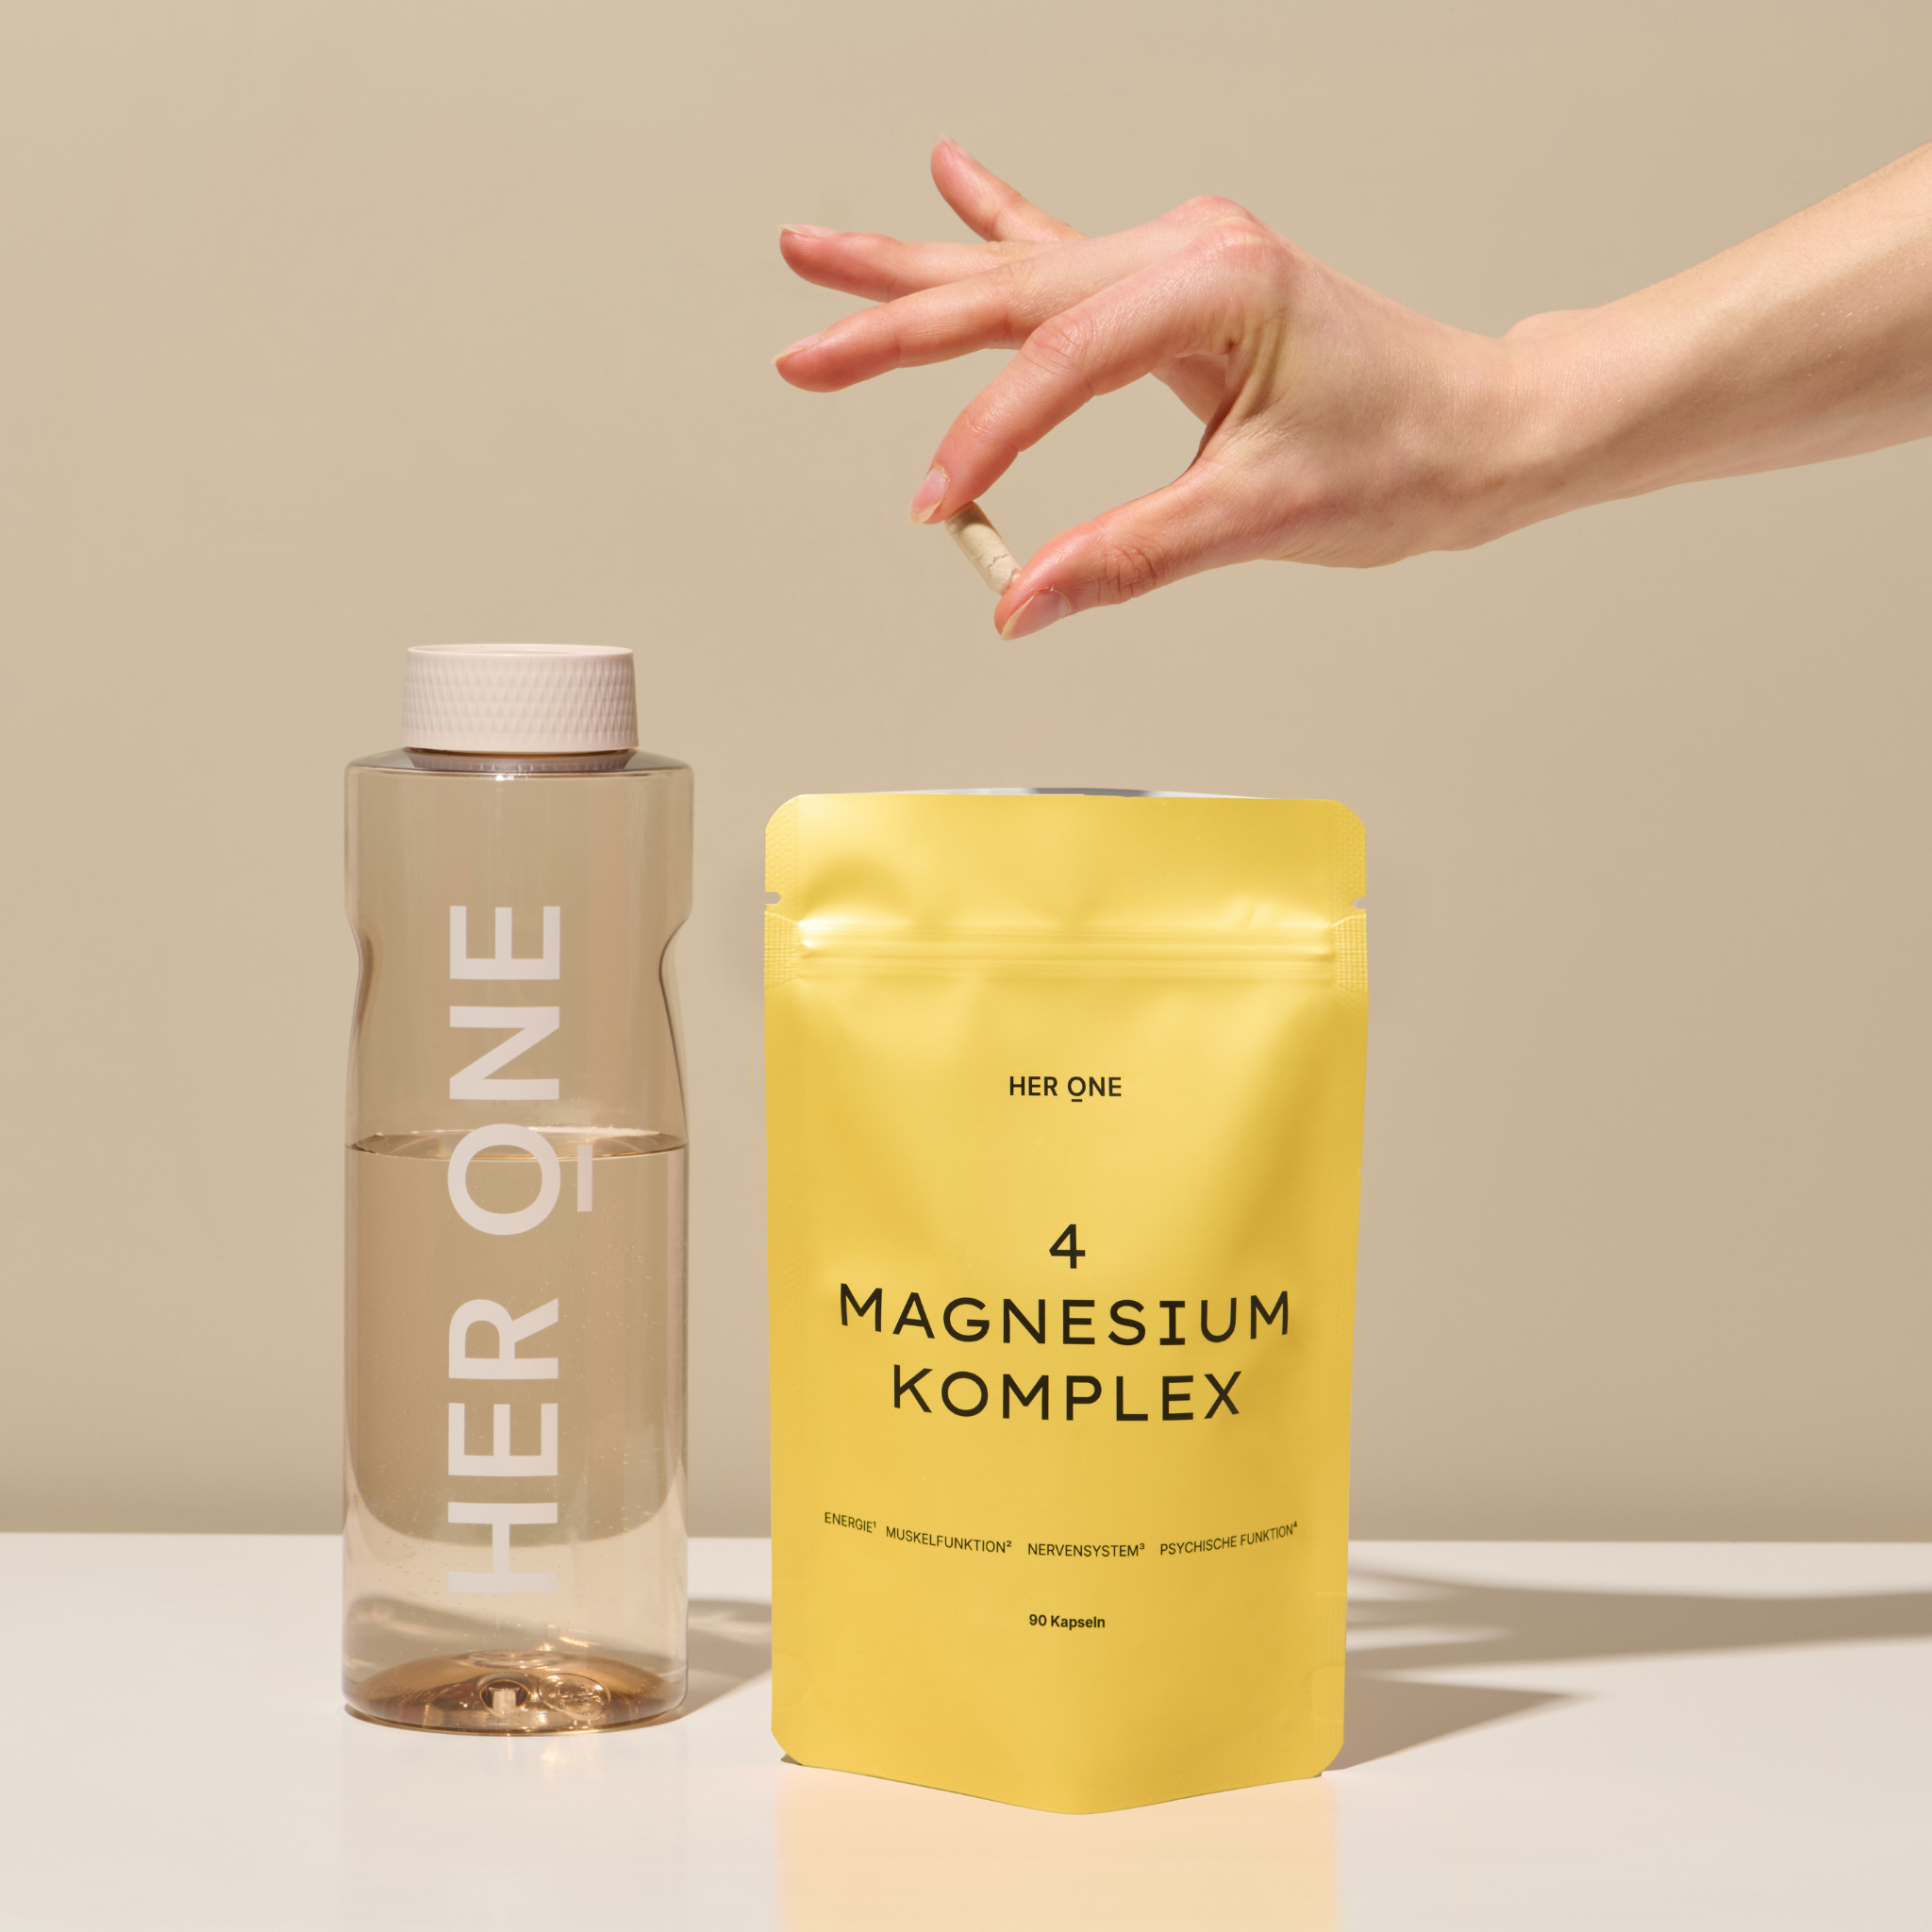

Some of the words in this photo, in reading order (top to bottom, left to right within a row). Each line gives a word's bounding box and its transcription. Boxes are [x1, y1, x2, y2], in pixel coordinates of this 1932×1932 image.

[447, 905, 592, 1236] ONE
[1009, 1075, 1058, 1097] HER
[1067, 1075, 1123, 1103] ONE
[1048, 1224, 1086, 1270] 4
[840, 1283, 1290, 1346] MAGNESIUM
[893, 1364, 1242, 1422] KOMPLEX
[447, 1297, 560, 1594] HER
[824, 1511, 877, 1533] ENERGIE¹
[885, 1525, 1013, 1554] MUSKELFUNKTION²
[1159, 1535, 1238, 1556] PSYCHISCHE
[1240, 1521, 1298, 1546] FUNKTION⁴
[1027, 1542, 1145, 1557] NERVENSYSTEM³
[1028, 1613, 1047, 1627] 90
[1050, 1614, 1106, 1631] Kapseln
